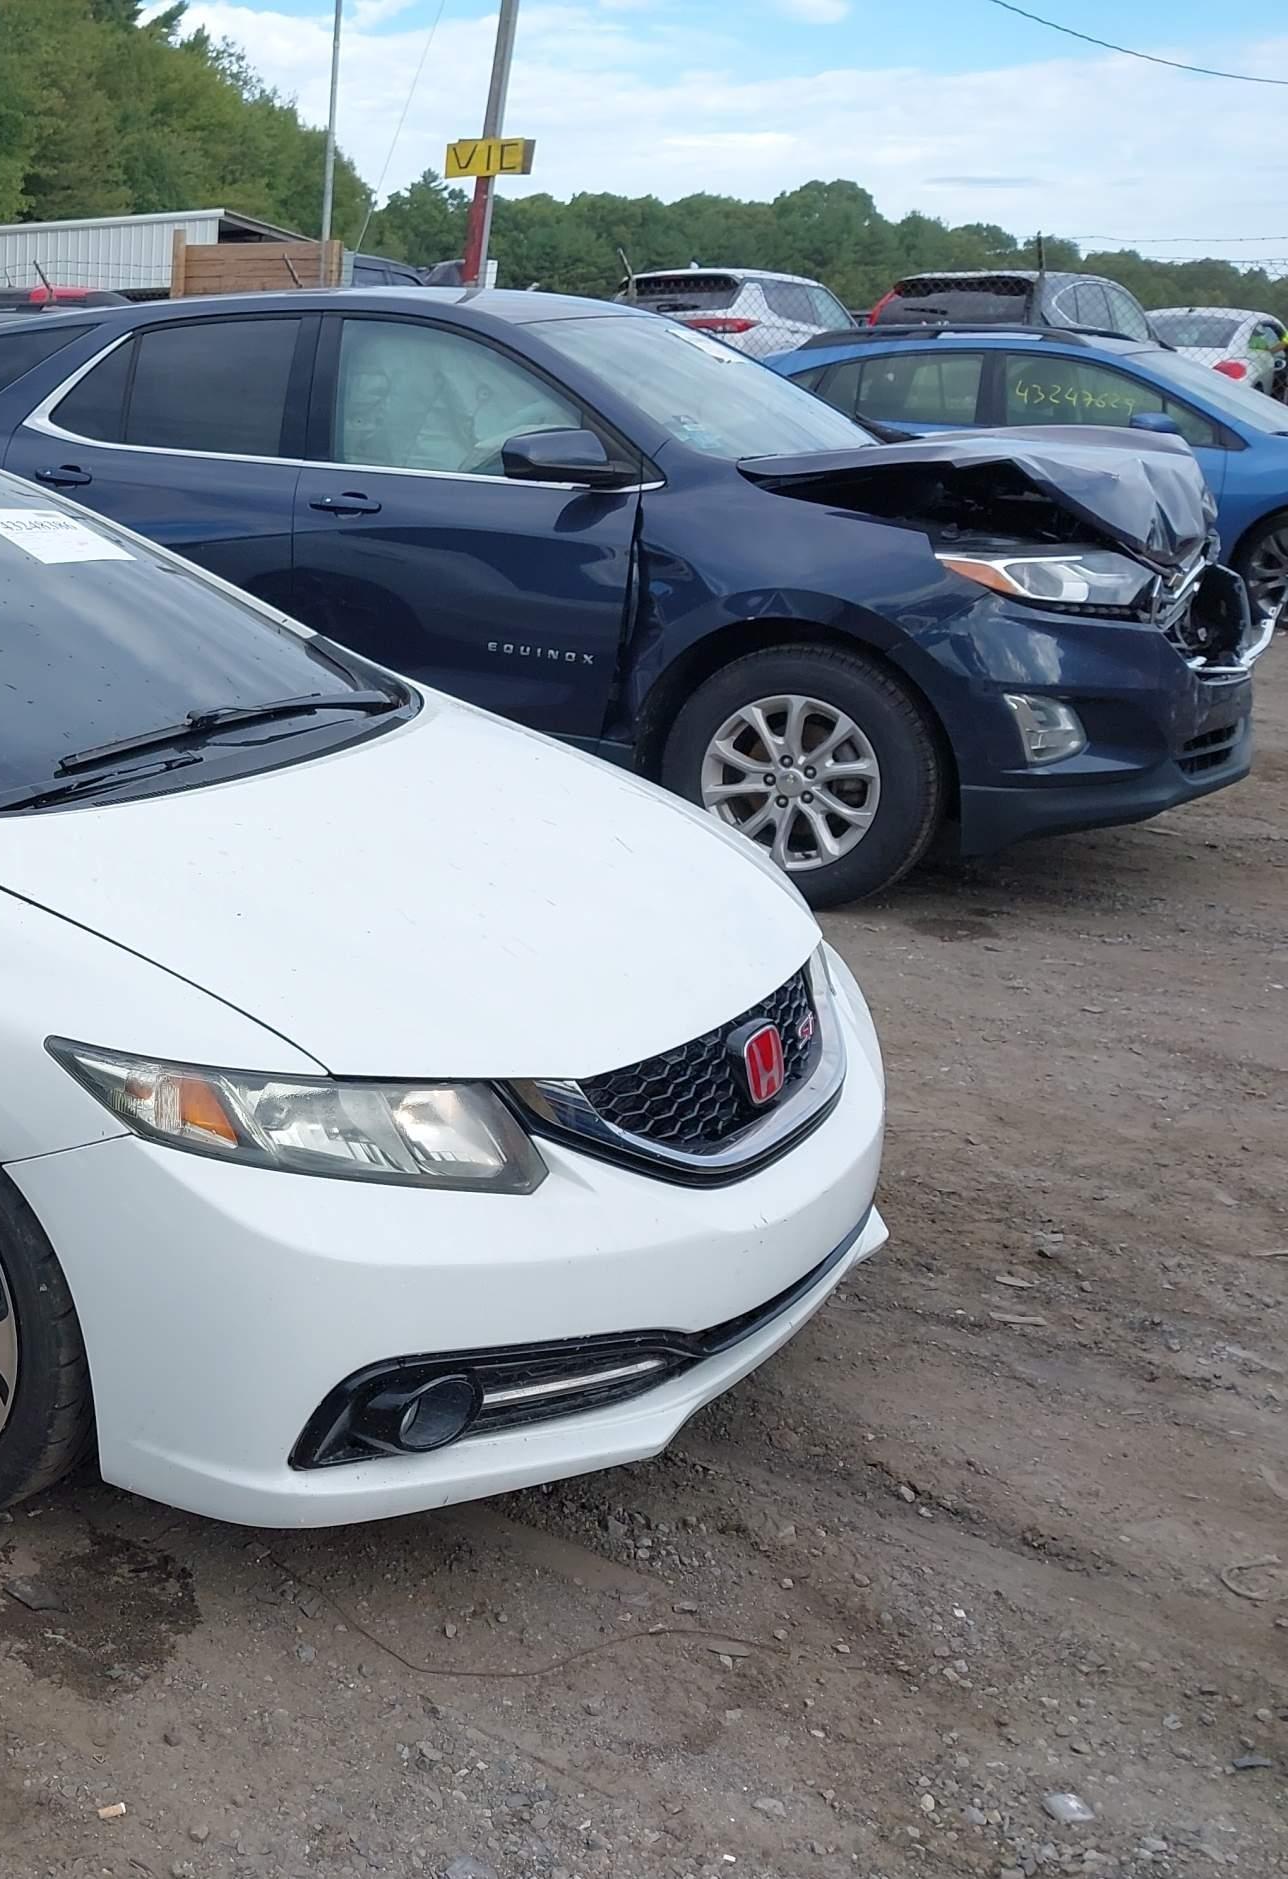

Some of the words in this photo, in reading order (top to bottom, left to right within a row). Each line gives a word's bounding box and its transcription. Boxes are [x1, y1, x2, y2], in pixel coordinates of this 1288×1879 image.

[452, 143, 519, 171] VIC
[1015, 379, 1136, 417] 43247629
[487, 642, 594, 665] EQUINOX
